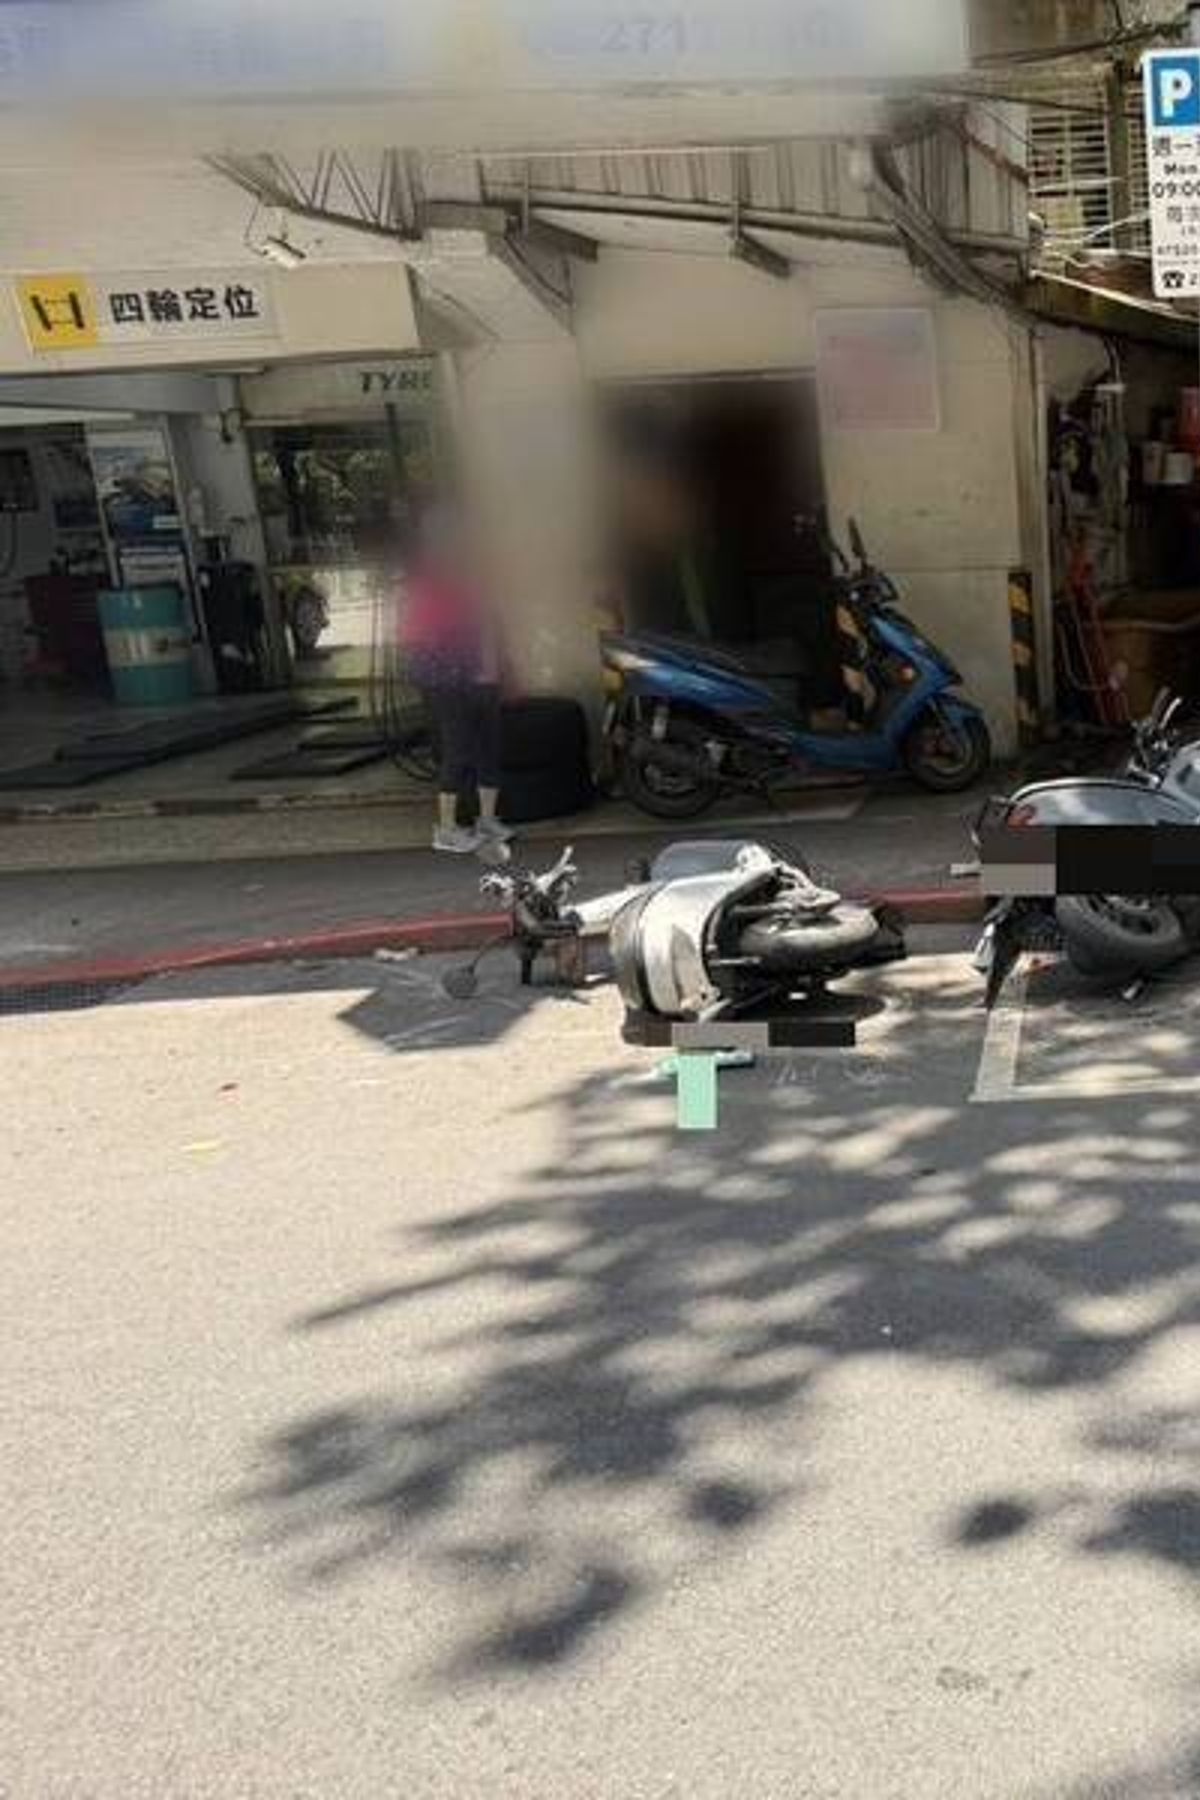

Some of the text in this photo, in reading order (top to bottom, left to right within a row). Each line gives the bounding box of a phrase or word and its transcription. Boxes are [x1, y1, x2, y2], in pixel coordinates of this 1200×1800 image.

[1159, 69, 1193, 118] P
[109, 286, 259, 324] 四輪定位
